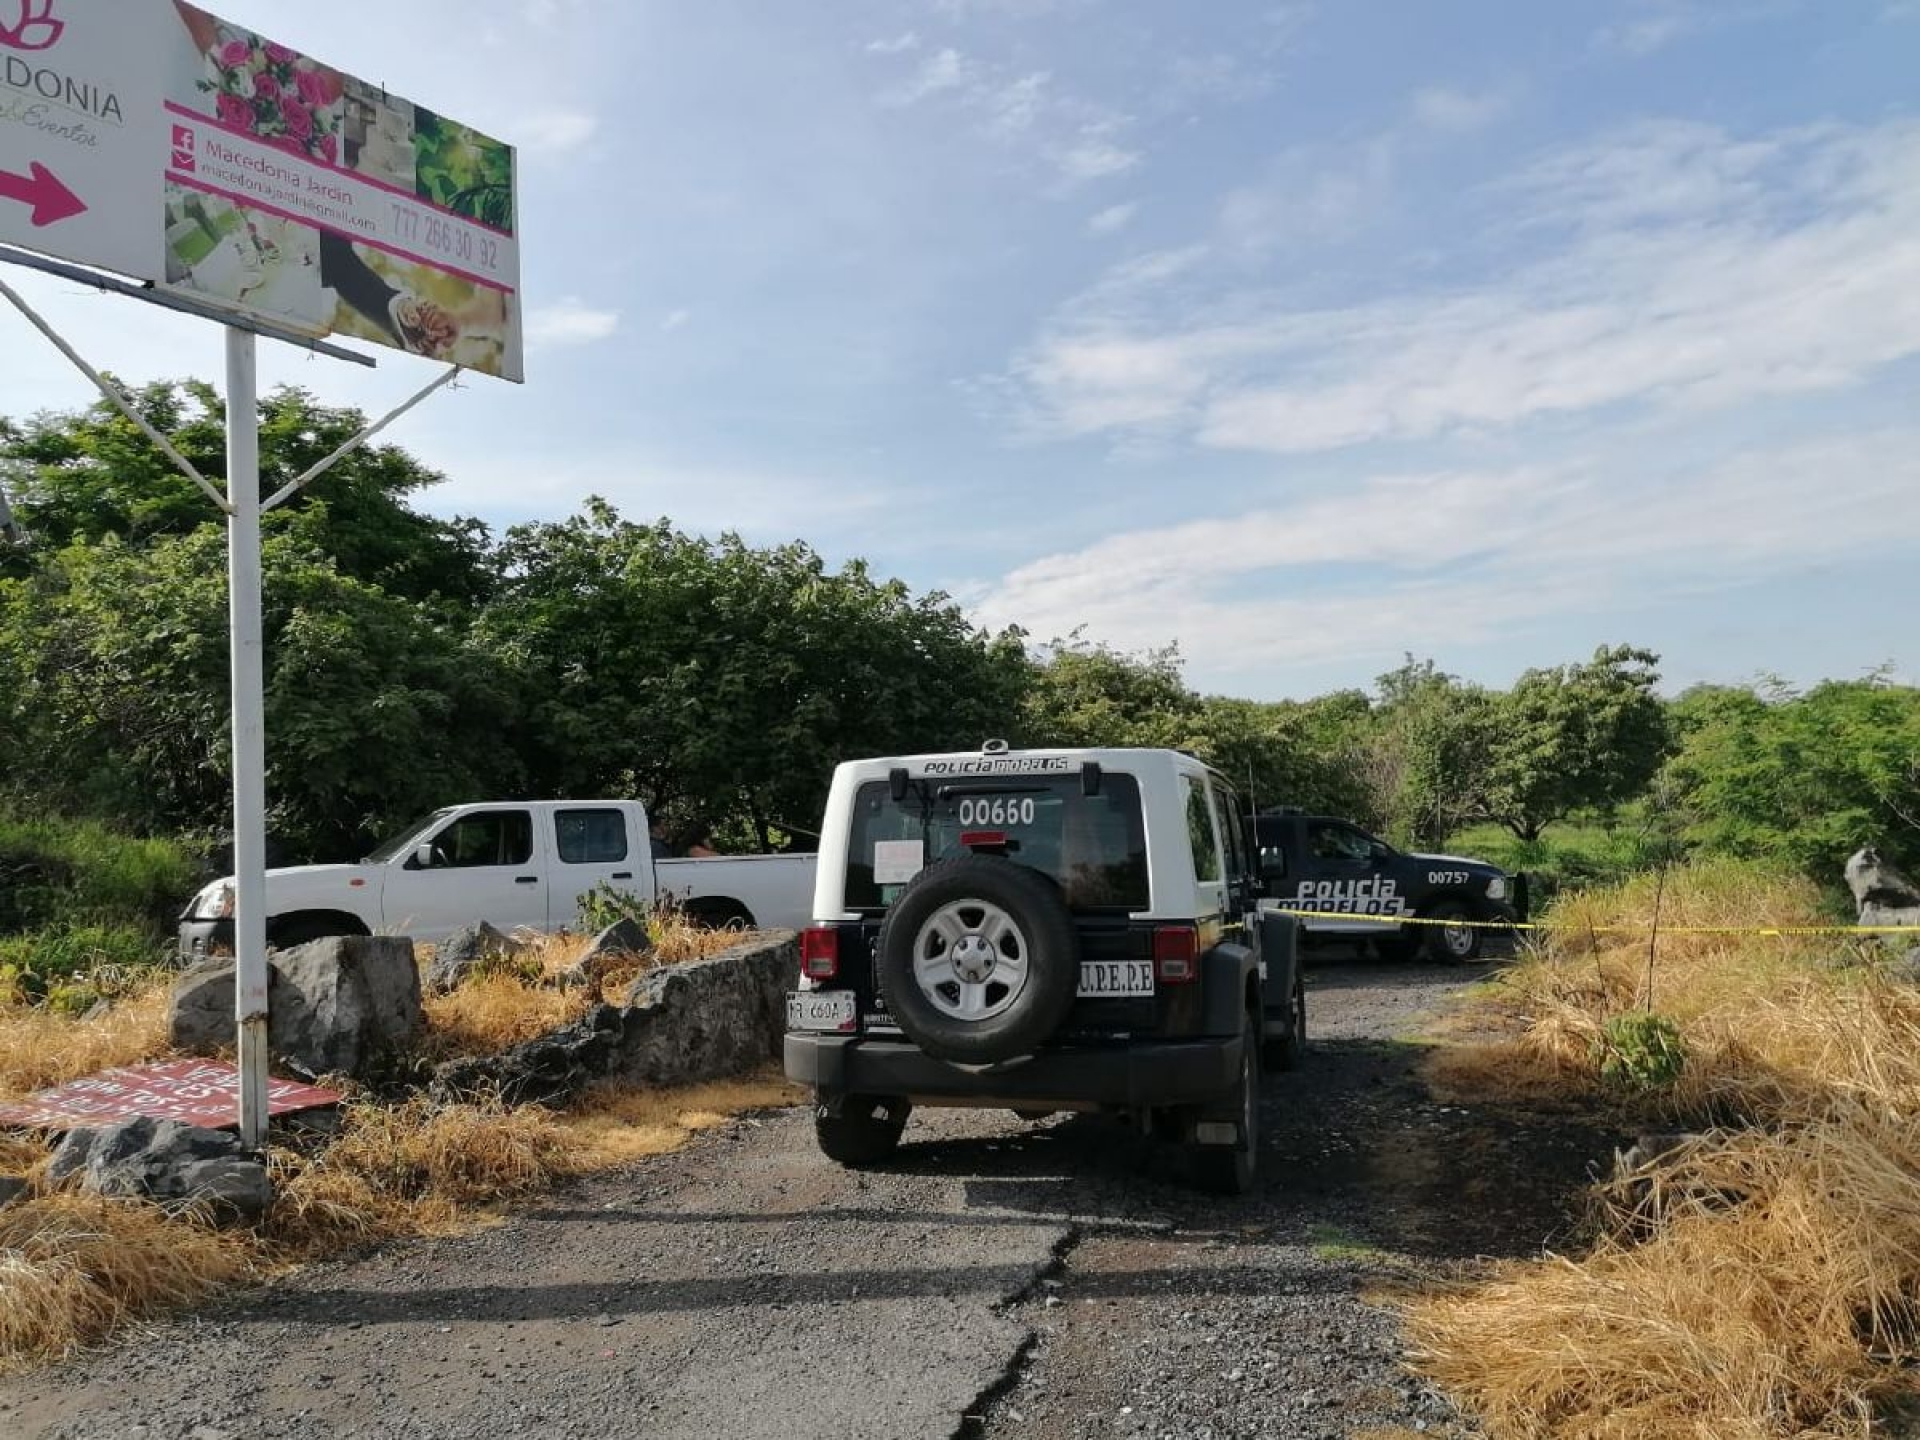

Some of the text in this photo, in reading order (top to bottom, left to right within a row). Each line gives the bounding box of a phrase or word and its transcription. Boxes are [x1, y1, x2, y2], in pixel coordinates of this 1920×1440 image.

[0, 53, 122, 123] DONIA
[206, 139, 300, 188] Macedonia
[391, 204, 419, 241] 777
[959, 797, 1035, 826] 00660
[1428, 871, 1470, 885] 00757
